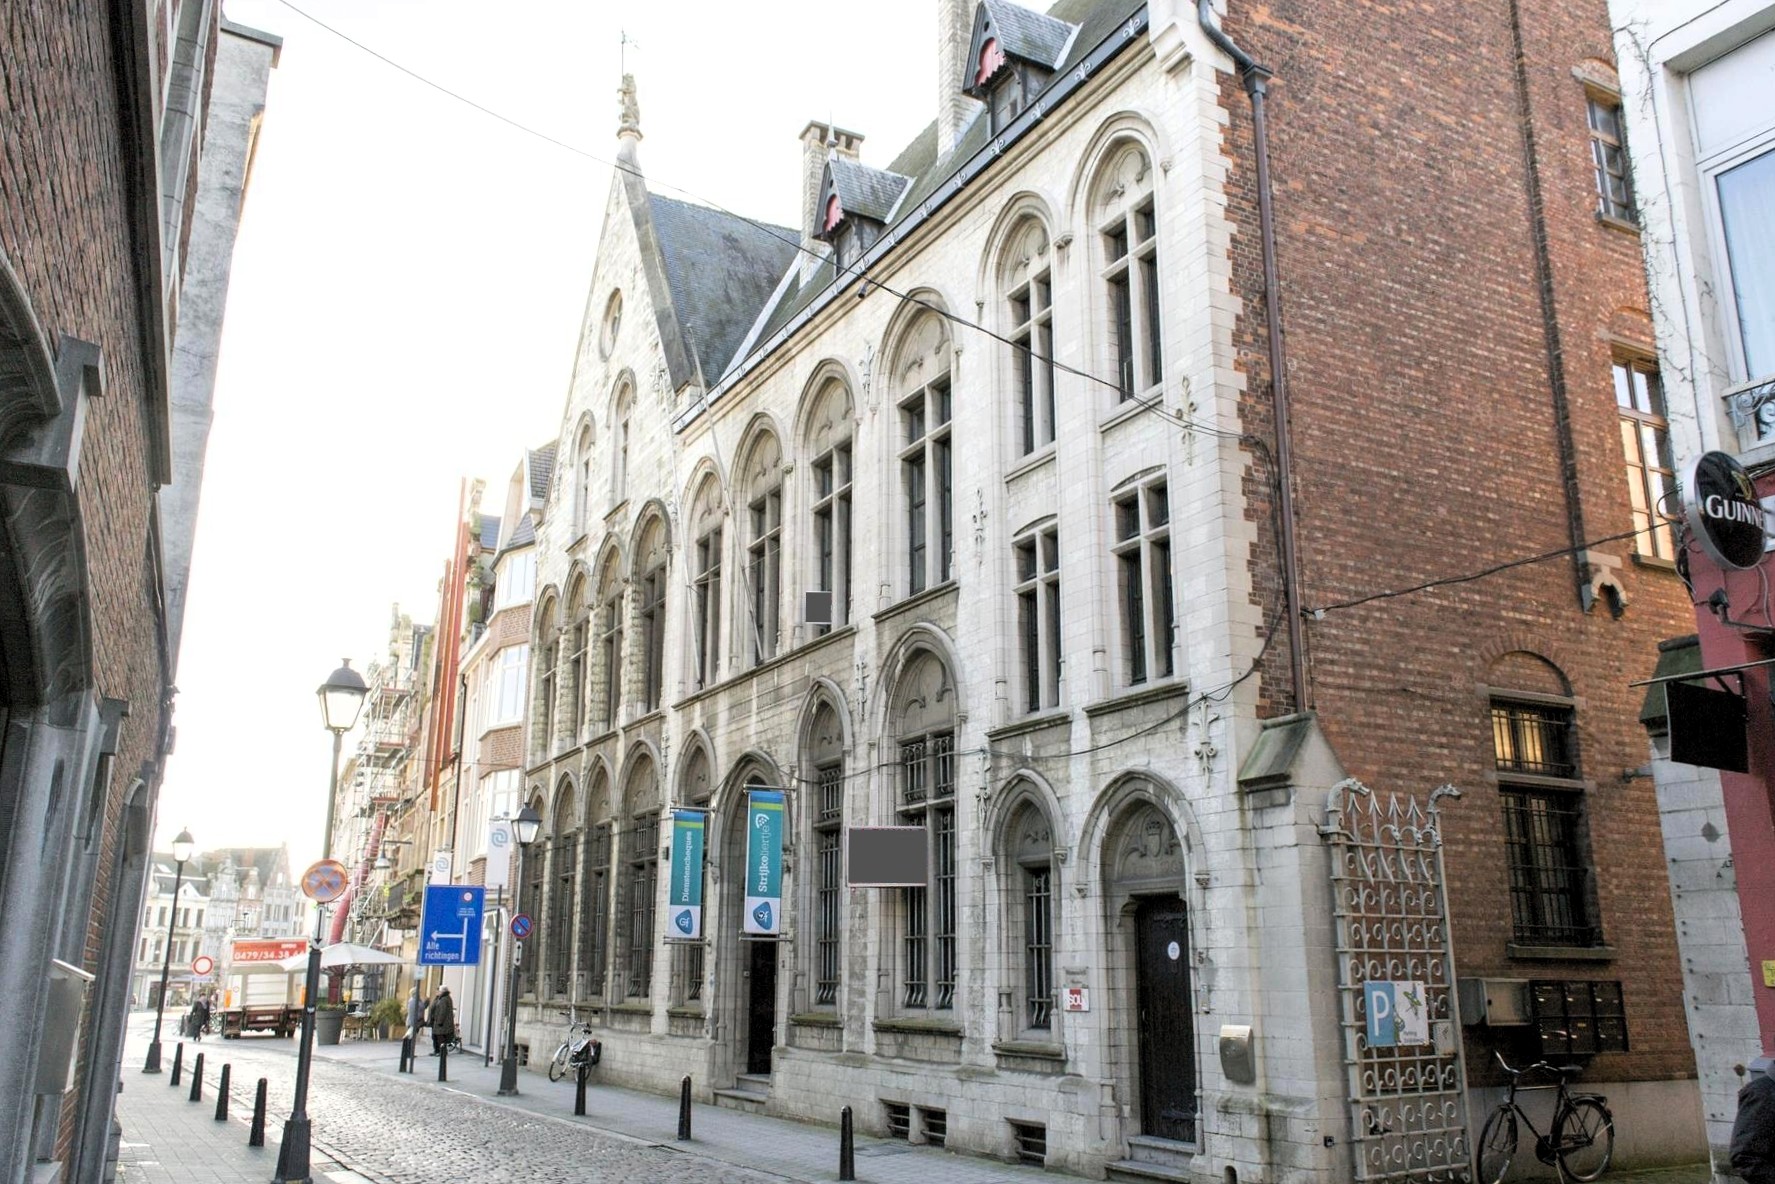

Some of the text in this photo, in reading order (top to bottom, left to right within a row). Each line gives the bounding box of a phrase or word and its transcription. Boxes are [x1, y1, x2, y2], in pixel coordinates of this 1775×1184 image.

[426, 941, 440, 950] Alle
[424, 951, 460, 962] richtingen
[1372, 990, 1390, 1037] P
